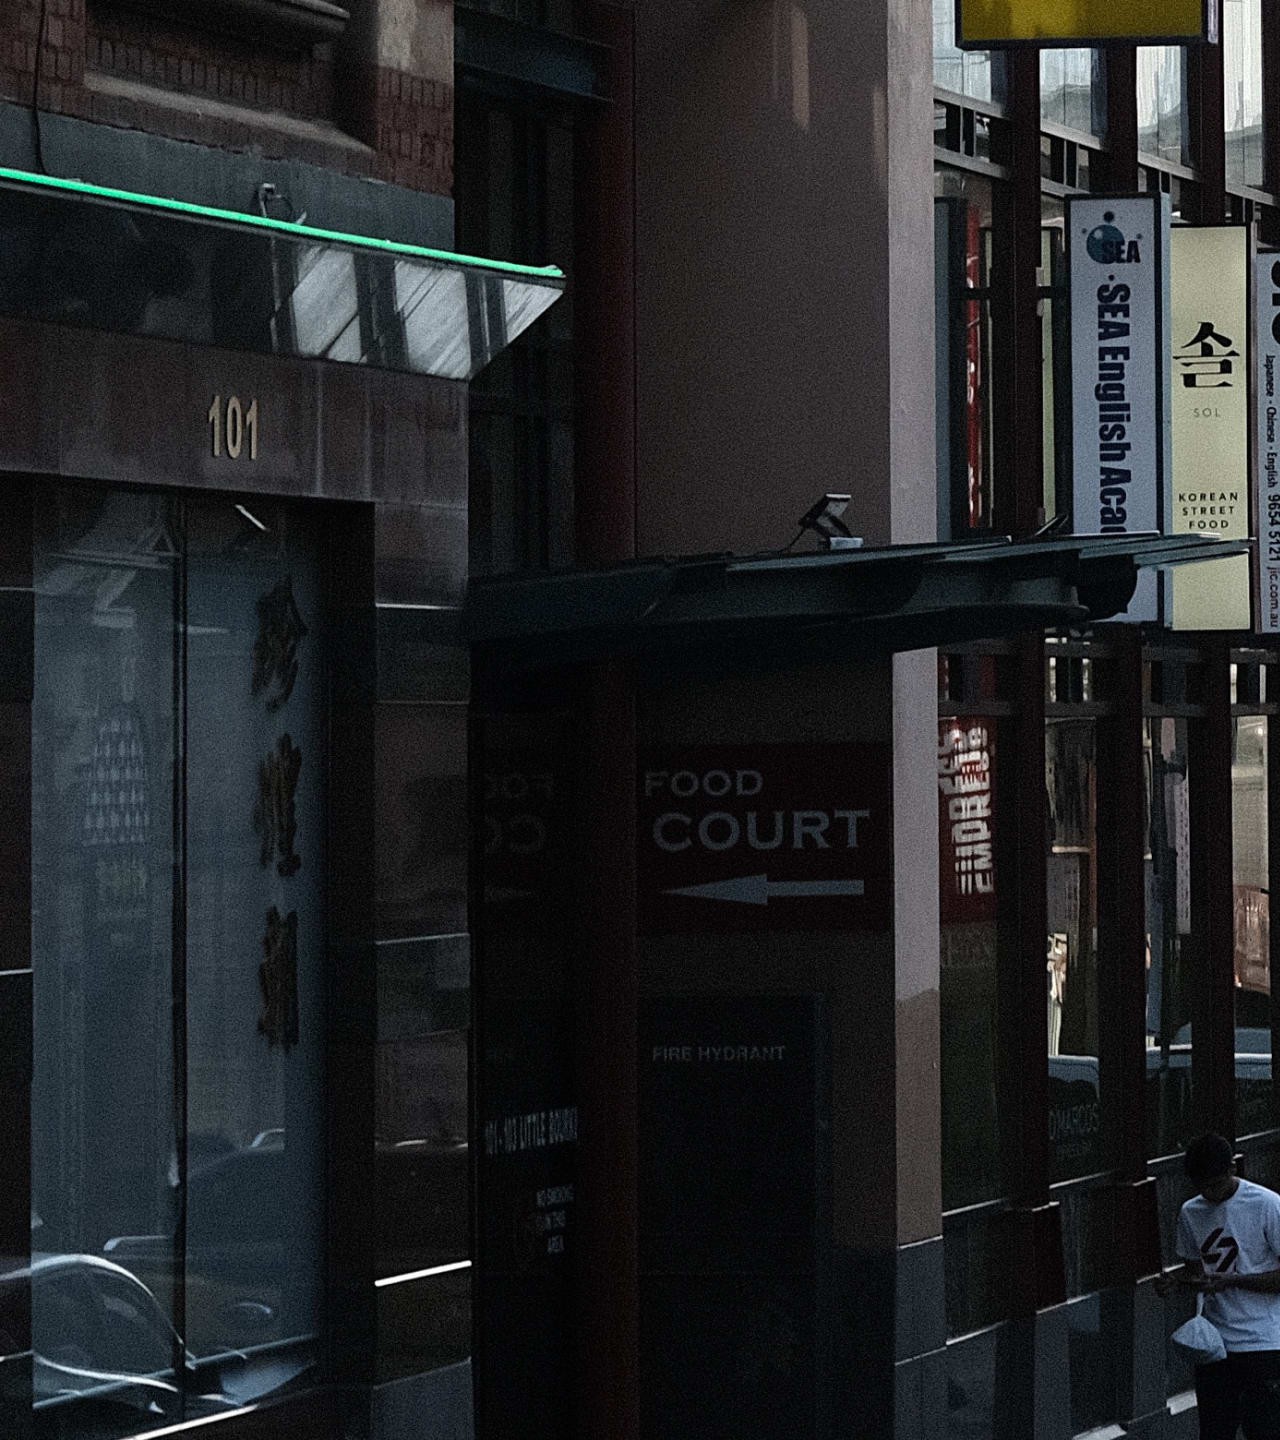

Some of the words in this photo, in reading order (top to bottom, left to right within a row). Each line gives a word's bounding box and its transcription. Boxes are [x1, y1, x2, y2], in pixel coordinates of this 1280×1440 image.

[1101, 240, 1141, 264] SEA
[1097, 282, 1131, 339] SEA
[1172, 322, 1240, 388] 솔
[1265, 355, 1276, 396] Japanese
[1095, 346, 1131, 461] English
[1193, 407, 1221, 418] SOL
[206, 393, 260, 462] 101
[1266, 406, 1277, 443] Chinese
[1266, 452, 1278, 488] English
[1178, 491, 1239, 502] KOREAN
[1182, 505, 1235, 516] STREET
[1268, 494, 1280, 528] 9654
[1188, 519, 1229, 530] FOOD
[1267, 566, 1280, 628] jic.com.au
[643, 769, 764, 800] FOOD
[652, 807, 872, 853] COURT
[652, 1045, 693, 1062] FIRE
[696, 1044, 786, 1061] HYDRANT
